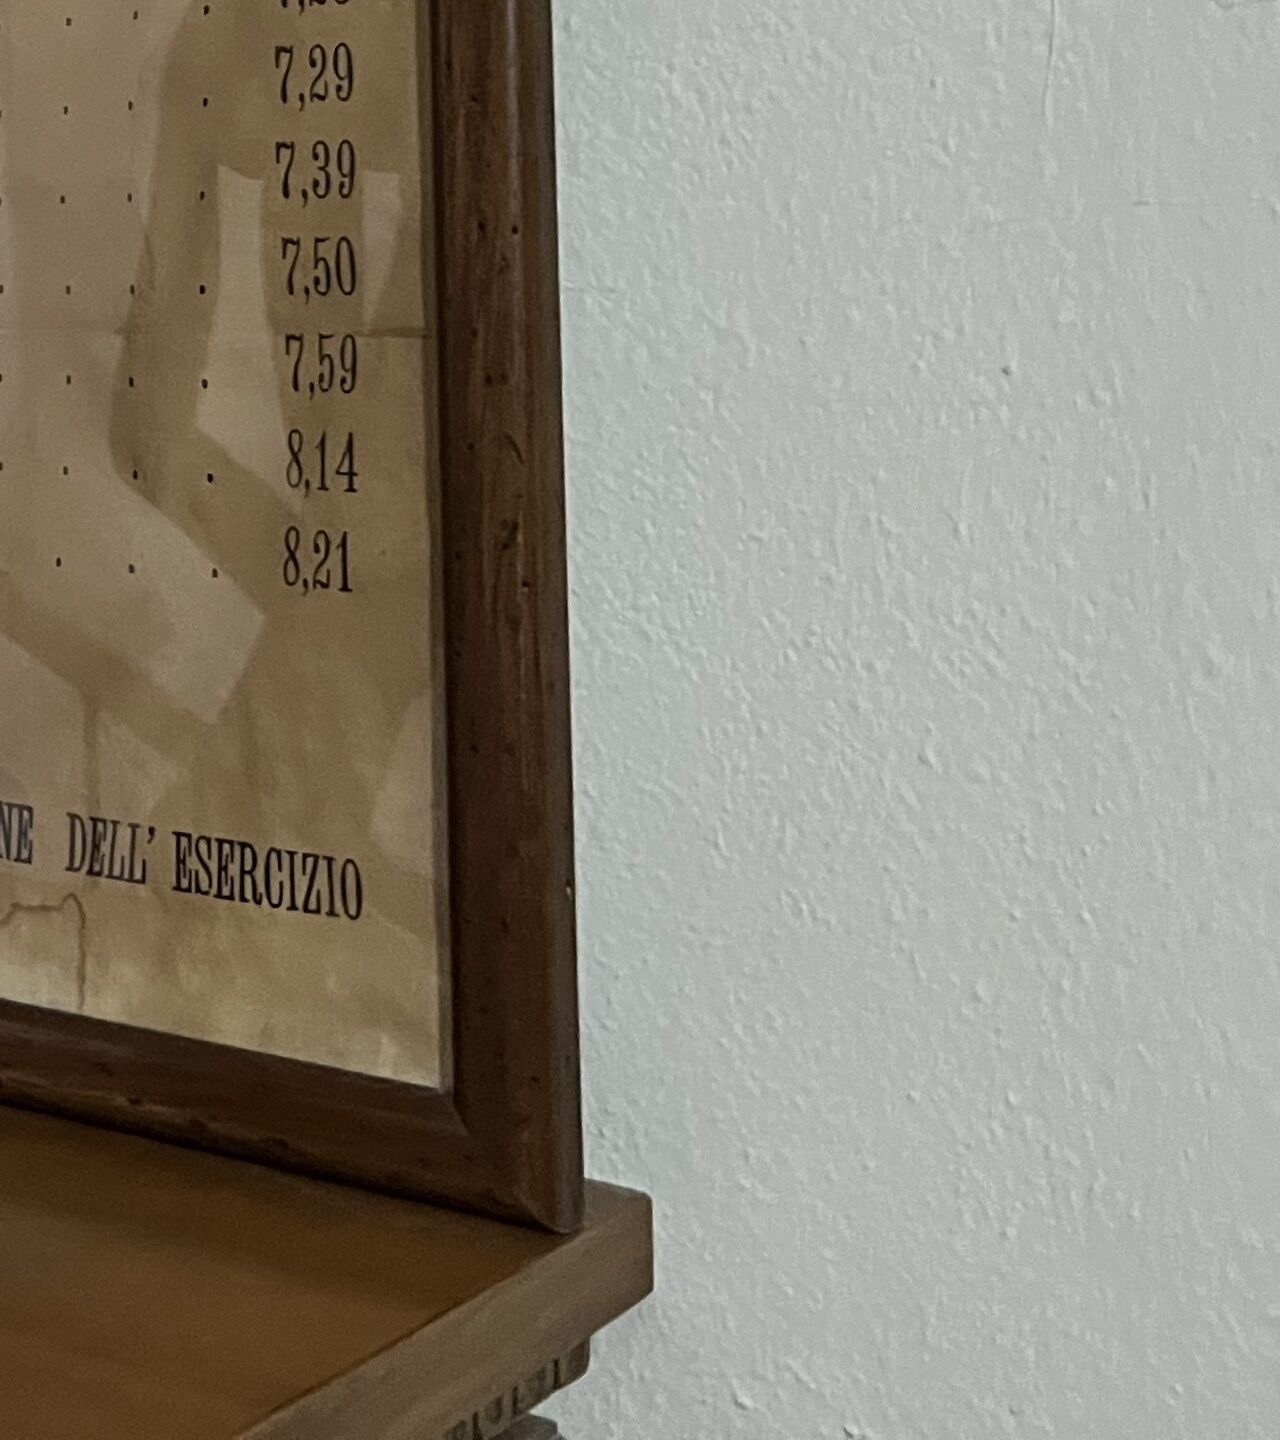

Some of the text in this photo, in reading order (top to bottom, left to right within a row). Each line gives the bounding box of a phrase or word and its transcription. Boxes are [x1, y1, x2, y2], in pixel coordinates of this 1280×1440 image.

[273, 42, 354, 111] 7,29
[274, 138, 356, 207] 7,39
[280, 235, 357, 305] 7,50
[284, 333, 358, 400] 7,59
[285, 428, 359, 498] 8,14
[281, 525, 354, 595] 8,21
